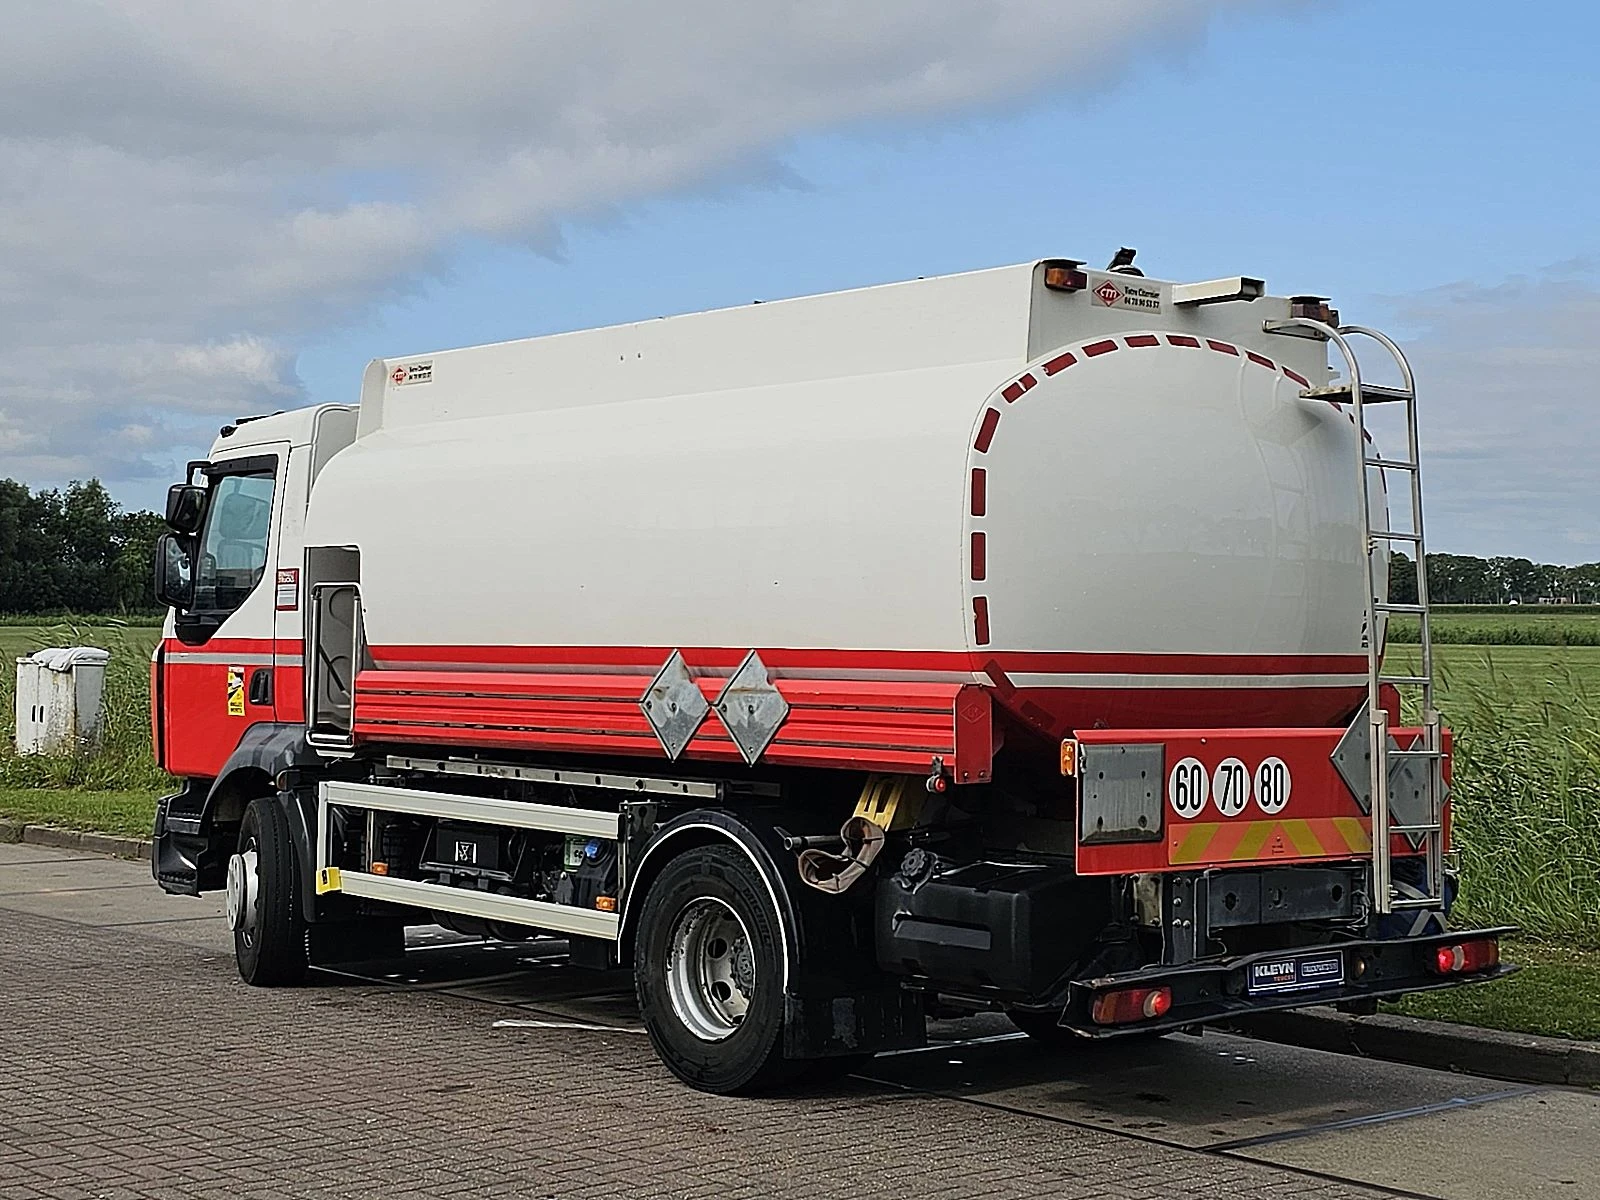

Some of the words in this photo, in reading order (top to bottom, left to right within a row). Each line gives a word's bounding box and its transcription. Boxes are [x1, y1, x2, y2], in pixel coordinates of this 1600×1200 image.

[1176, 764, 1201, 811] 60
[1220, 764, 1244, 811] 70
[1260, 763, 1284, 807] 80
